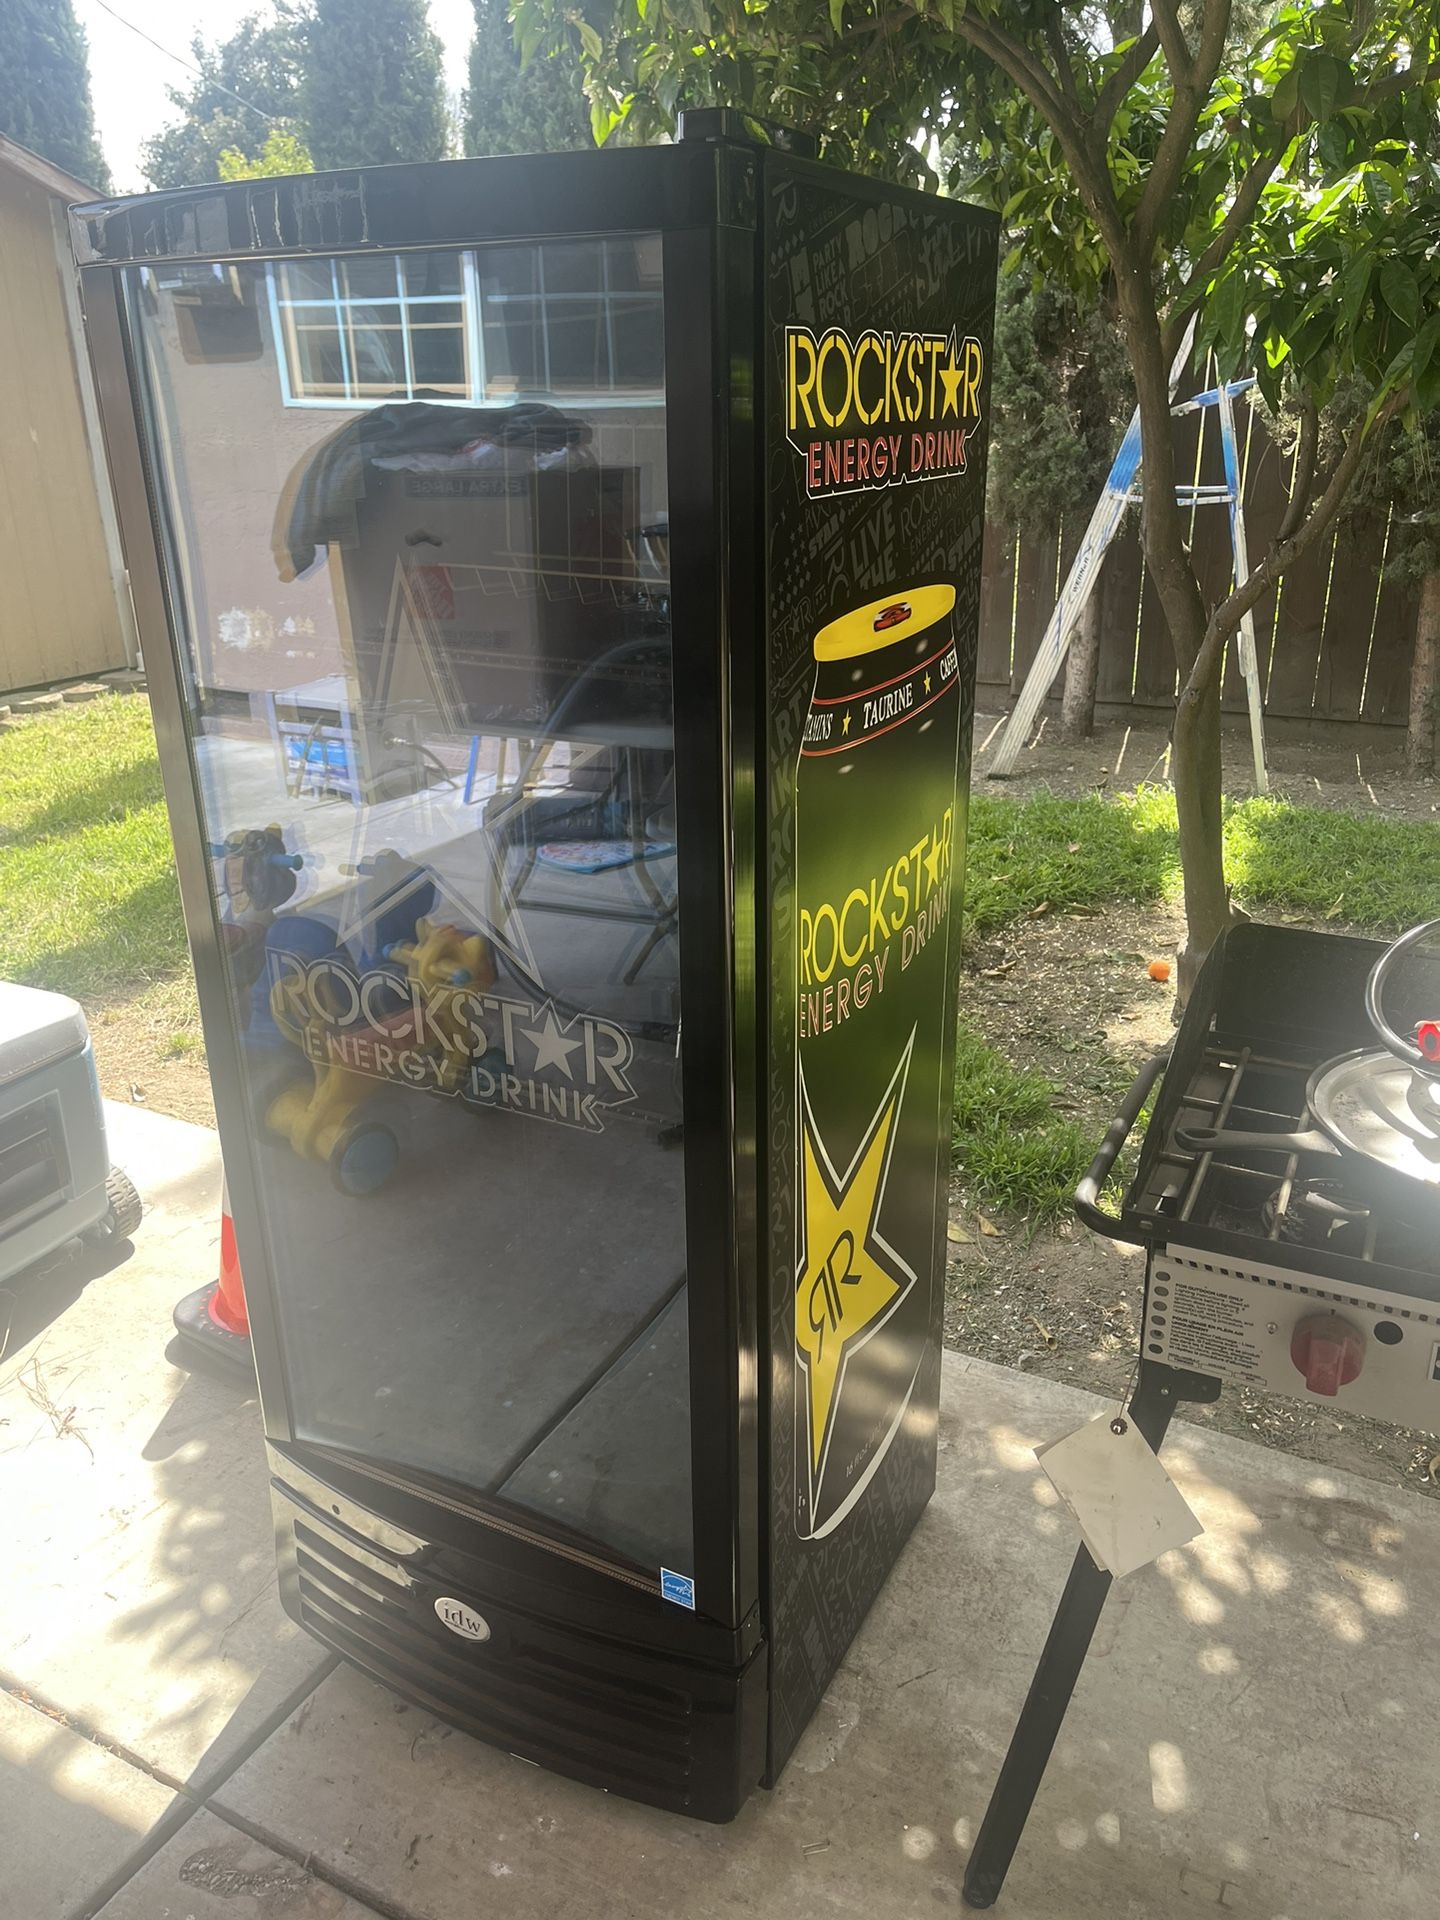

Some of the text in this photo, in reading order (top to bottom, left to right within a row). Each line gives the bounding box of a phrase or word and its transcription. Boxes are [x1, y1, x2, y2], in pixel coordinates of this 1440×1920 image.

[789, 334, 979, 430] ROCKSTAR
[808, 428, 966, 488] ENERGY DRINK
[850, 495, 896, 582] LIVE
[863, 682, 913, 729] TAURINE
[801, 808, 952, 985] ROCKSTAR
[800, 874, 949, 1038] ENERGY DRINK
[272, 950, 628, 1093] ROCKSTAR
[304, 1025, 600, 1126] ENERGY DRINK
